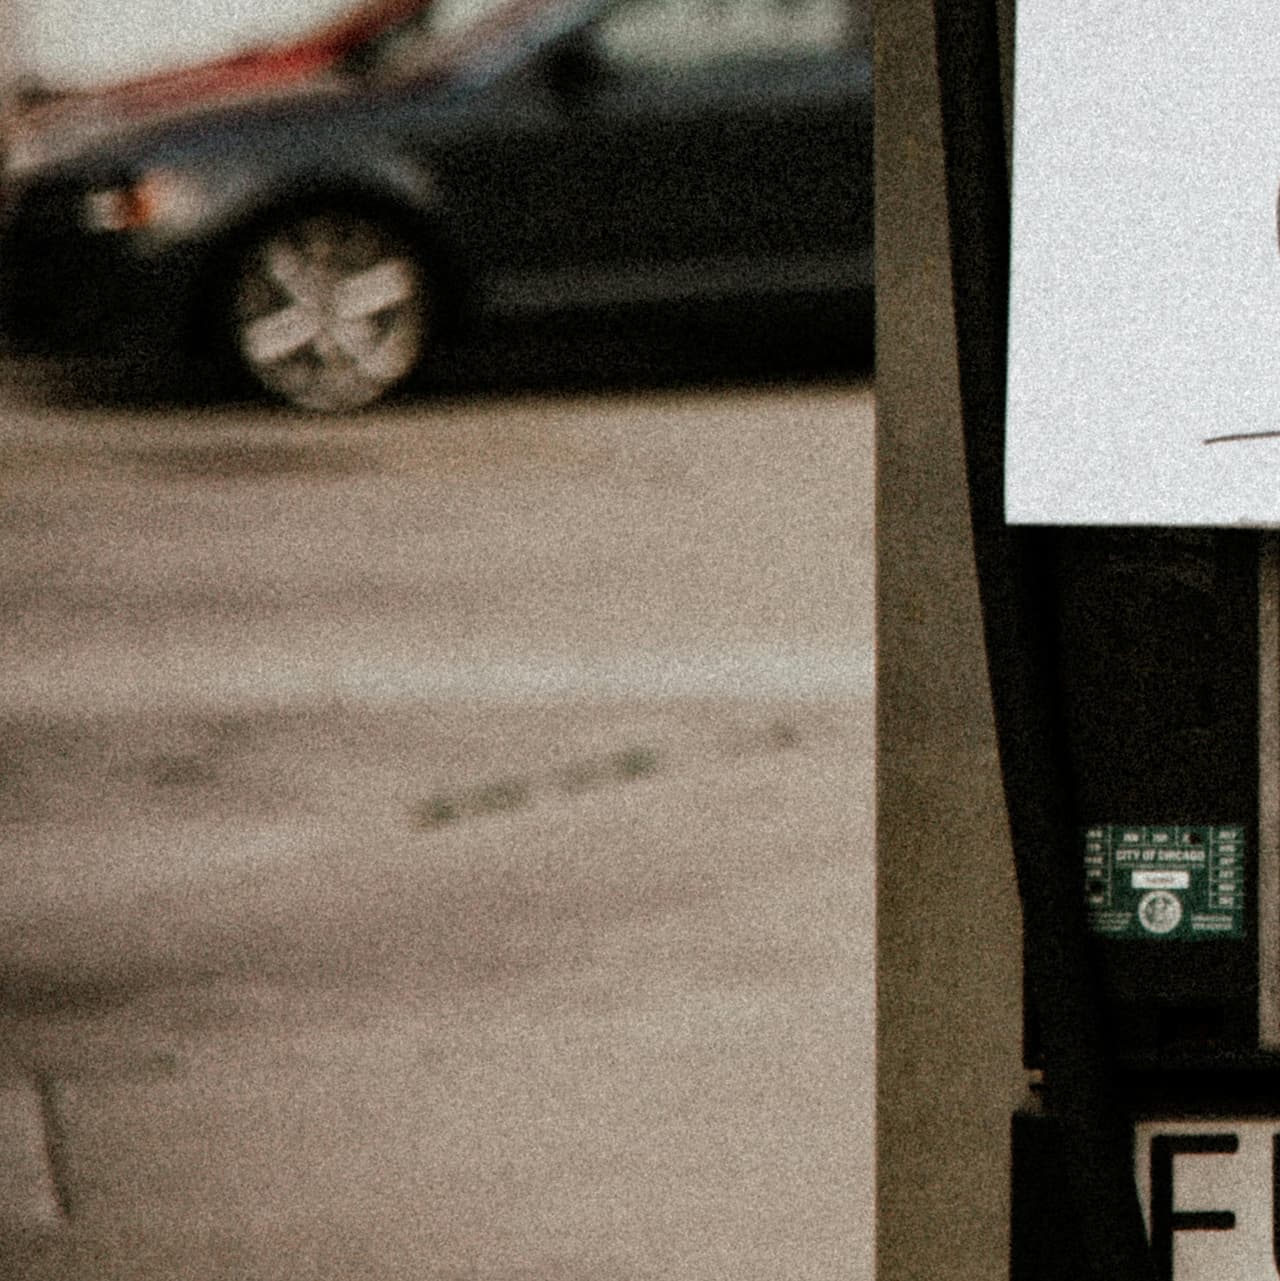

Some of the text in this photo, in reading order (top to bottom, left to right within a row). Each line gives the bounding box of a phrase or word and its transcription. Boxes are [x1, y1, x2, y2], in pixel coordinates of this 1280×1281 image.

[1115, 850, 1206, 862] CITY OF CHICAGO
